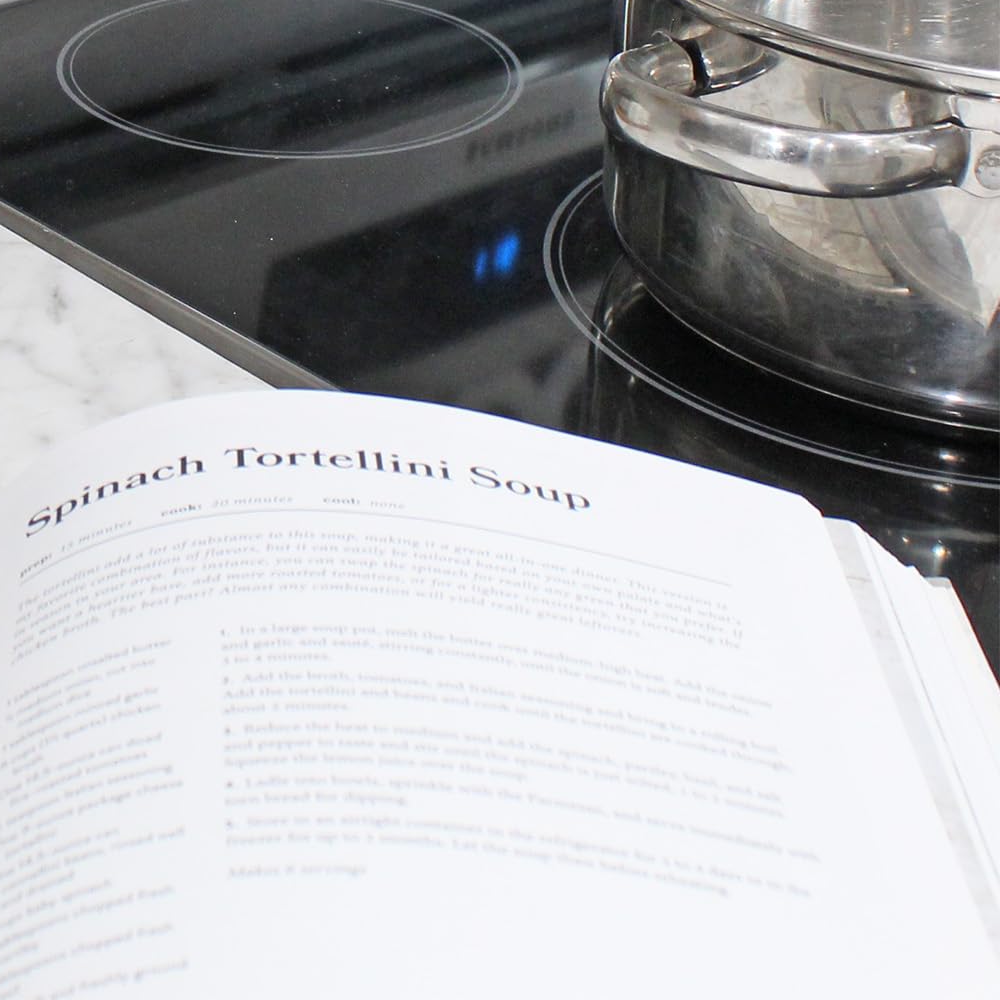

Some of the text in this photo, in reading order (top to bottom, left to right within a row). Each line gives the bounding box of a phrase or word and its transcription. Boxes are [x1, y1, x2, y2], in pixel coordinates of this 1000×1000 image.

[26, 447, 592, 538] Spinach Tortellini Soup
